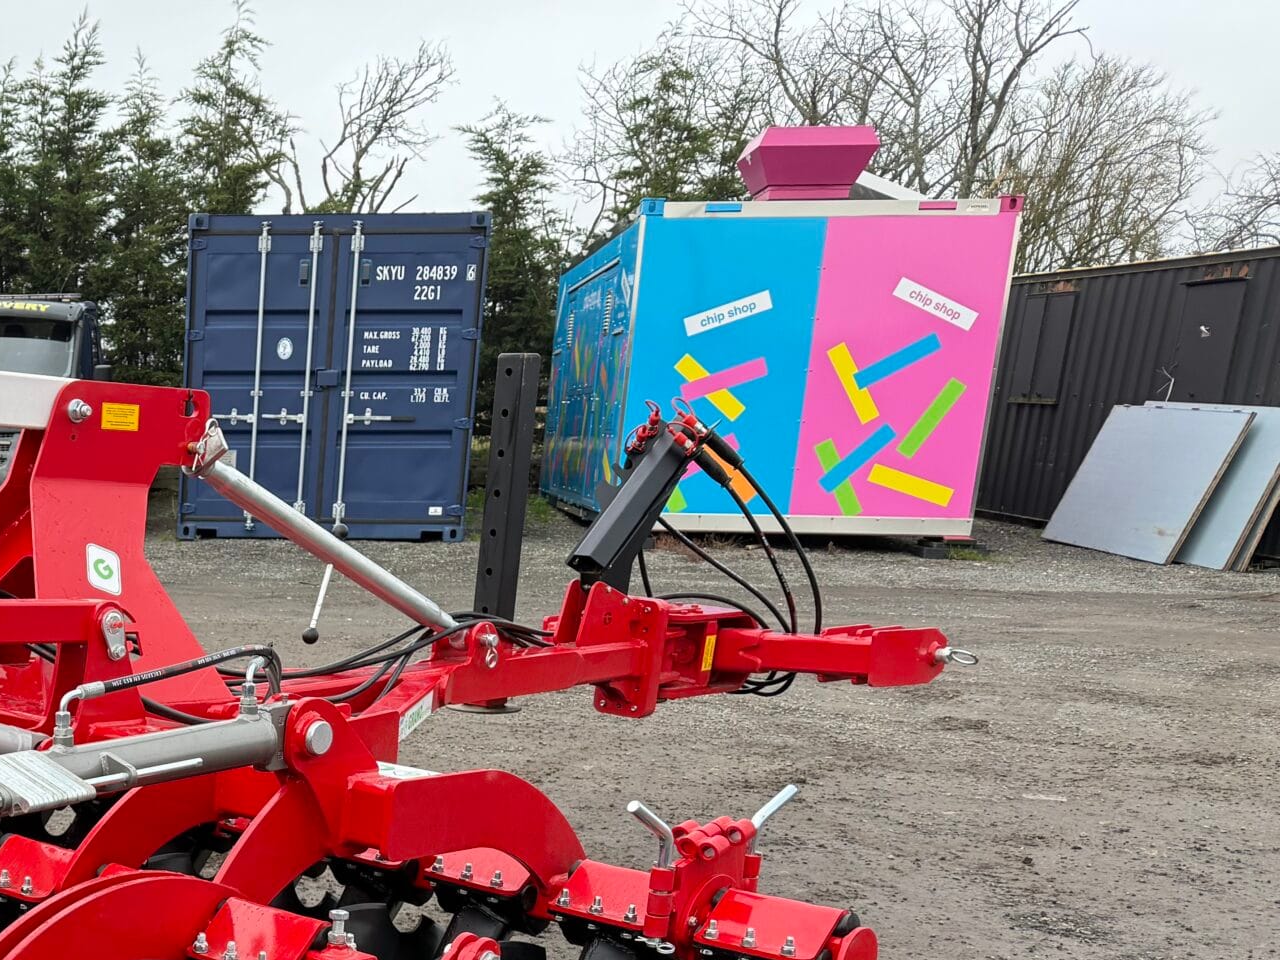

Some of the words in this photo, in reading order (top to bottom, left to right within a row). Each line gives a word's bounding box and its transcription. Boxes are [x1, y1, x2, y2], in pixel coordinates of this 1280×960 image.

[376, 265, 405, 280] SKYU
[416, 265, 458, 280] 284839
[467, 265, 475, 280] 6
[414, 285, 440, 300] 22G1
[909, 290, 932, 307] chip
[933, 302, 960, 321] shop
[700, 312, 725, 327] chip
[727, 302, 756, 318] shop
[363, 345, 380, 354] TARE
[361, 359, 393, 368] PAYLOAD
